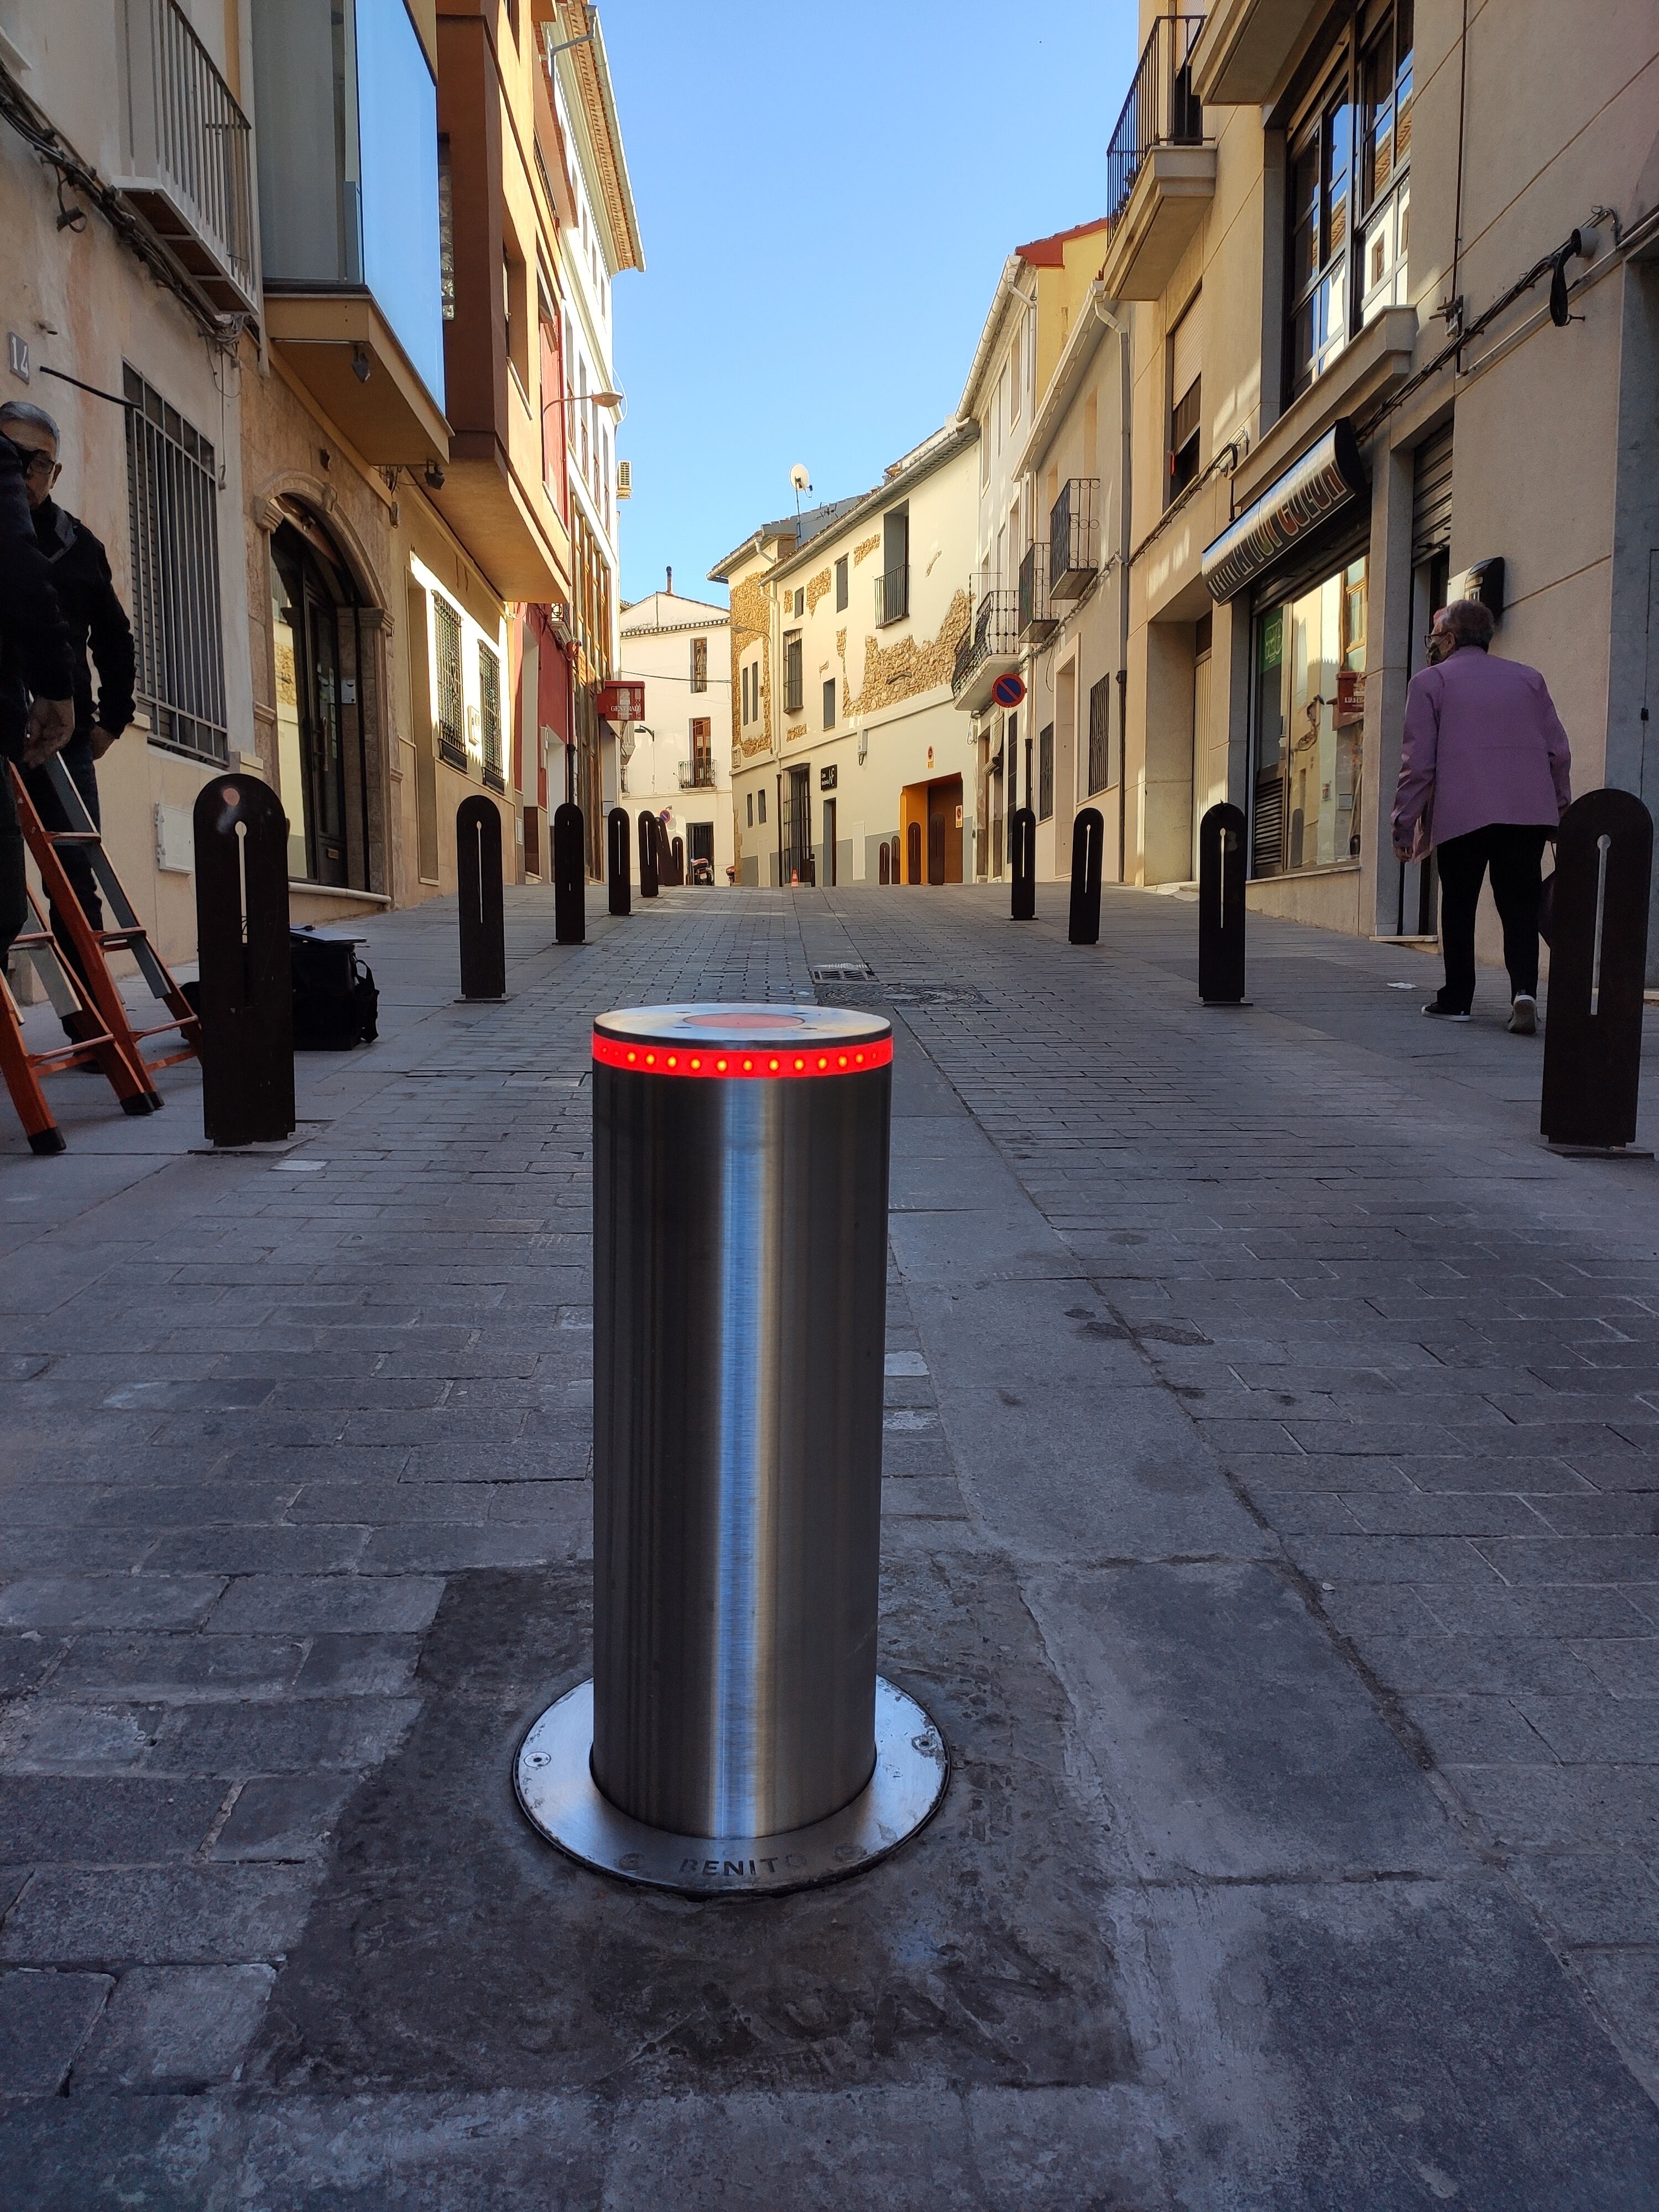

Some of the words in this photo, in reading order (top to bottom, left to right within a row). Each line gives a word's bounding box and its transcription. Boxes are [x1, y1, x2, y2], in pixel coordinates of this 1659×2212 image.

[12, 336, 29, 378] 14
[1276, 437, 1348, 536] COLOR
[678, 1853, 807, 1877] BENITO
